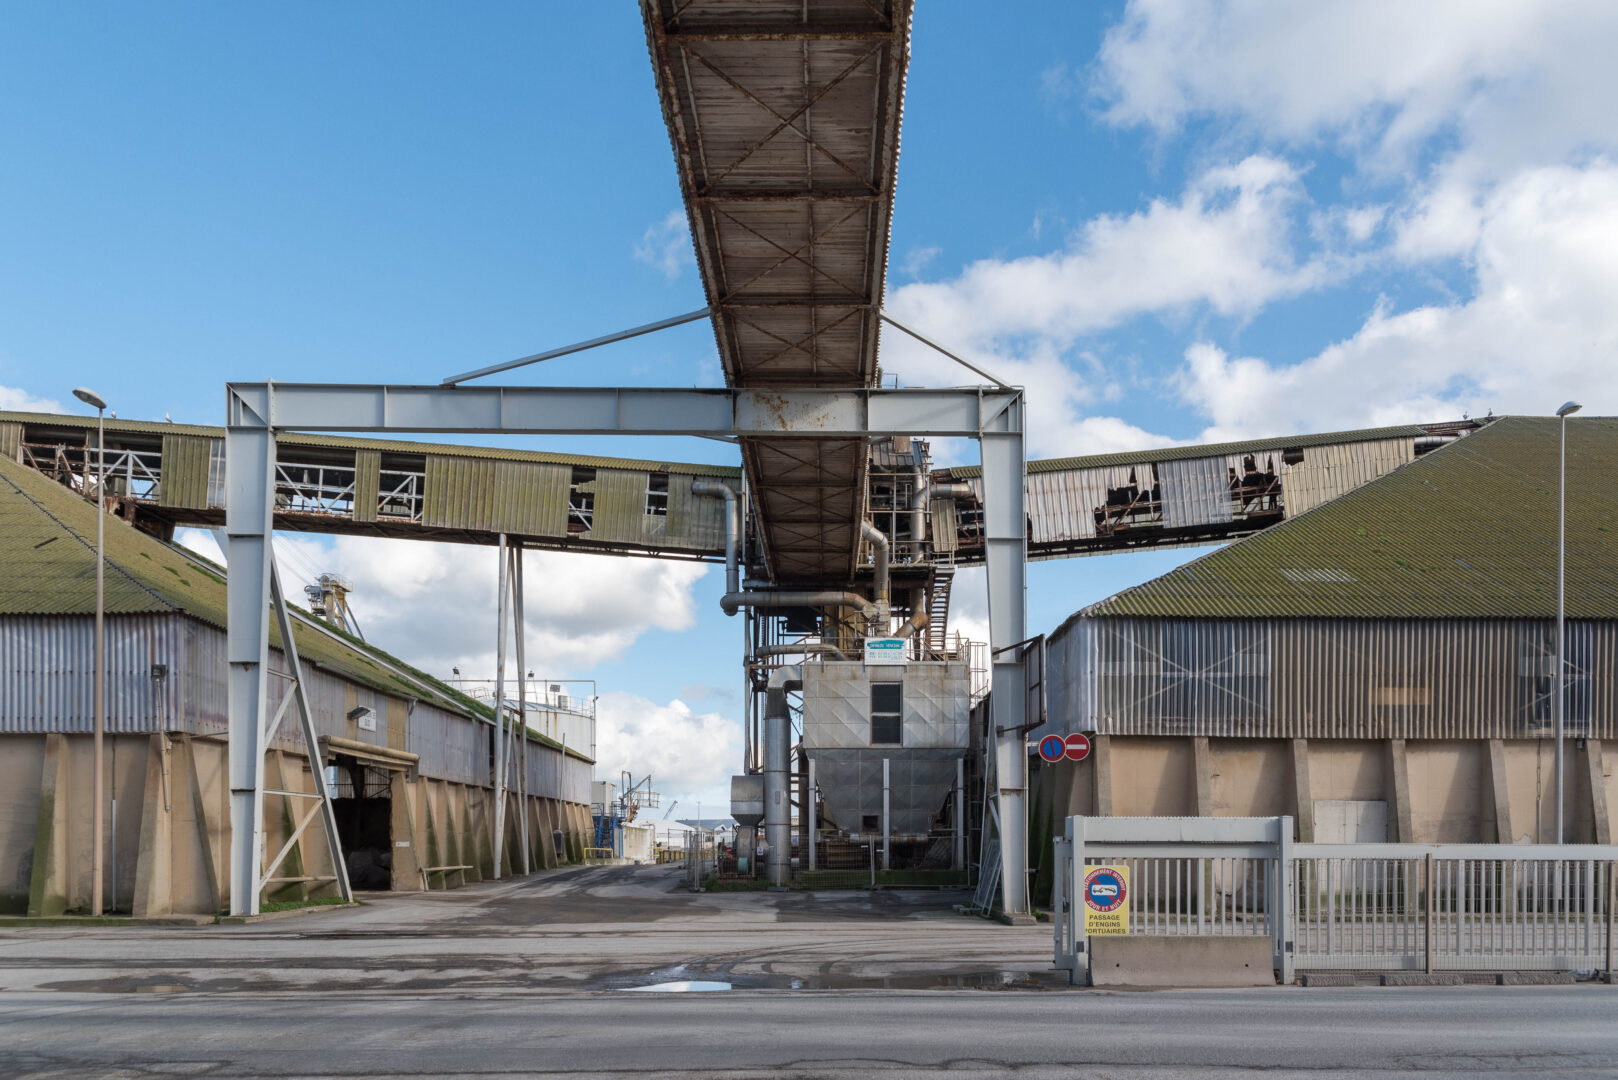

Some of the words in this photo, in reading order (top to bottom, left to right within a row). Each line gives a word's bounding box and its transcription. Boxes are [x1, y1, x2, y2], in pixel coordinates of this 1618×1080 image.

[1112, 871, 1126, 890] INTERDIT
[1087, 899, 1101, 911] JOUR
[1110, 899, 1122, 910] NUIT
